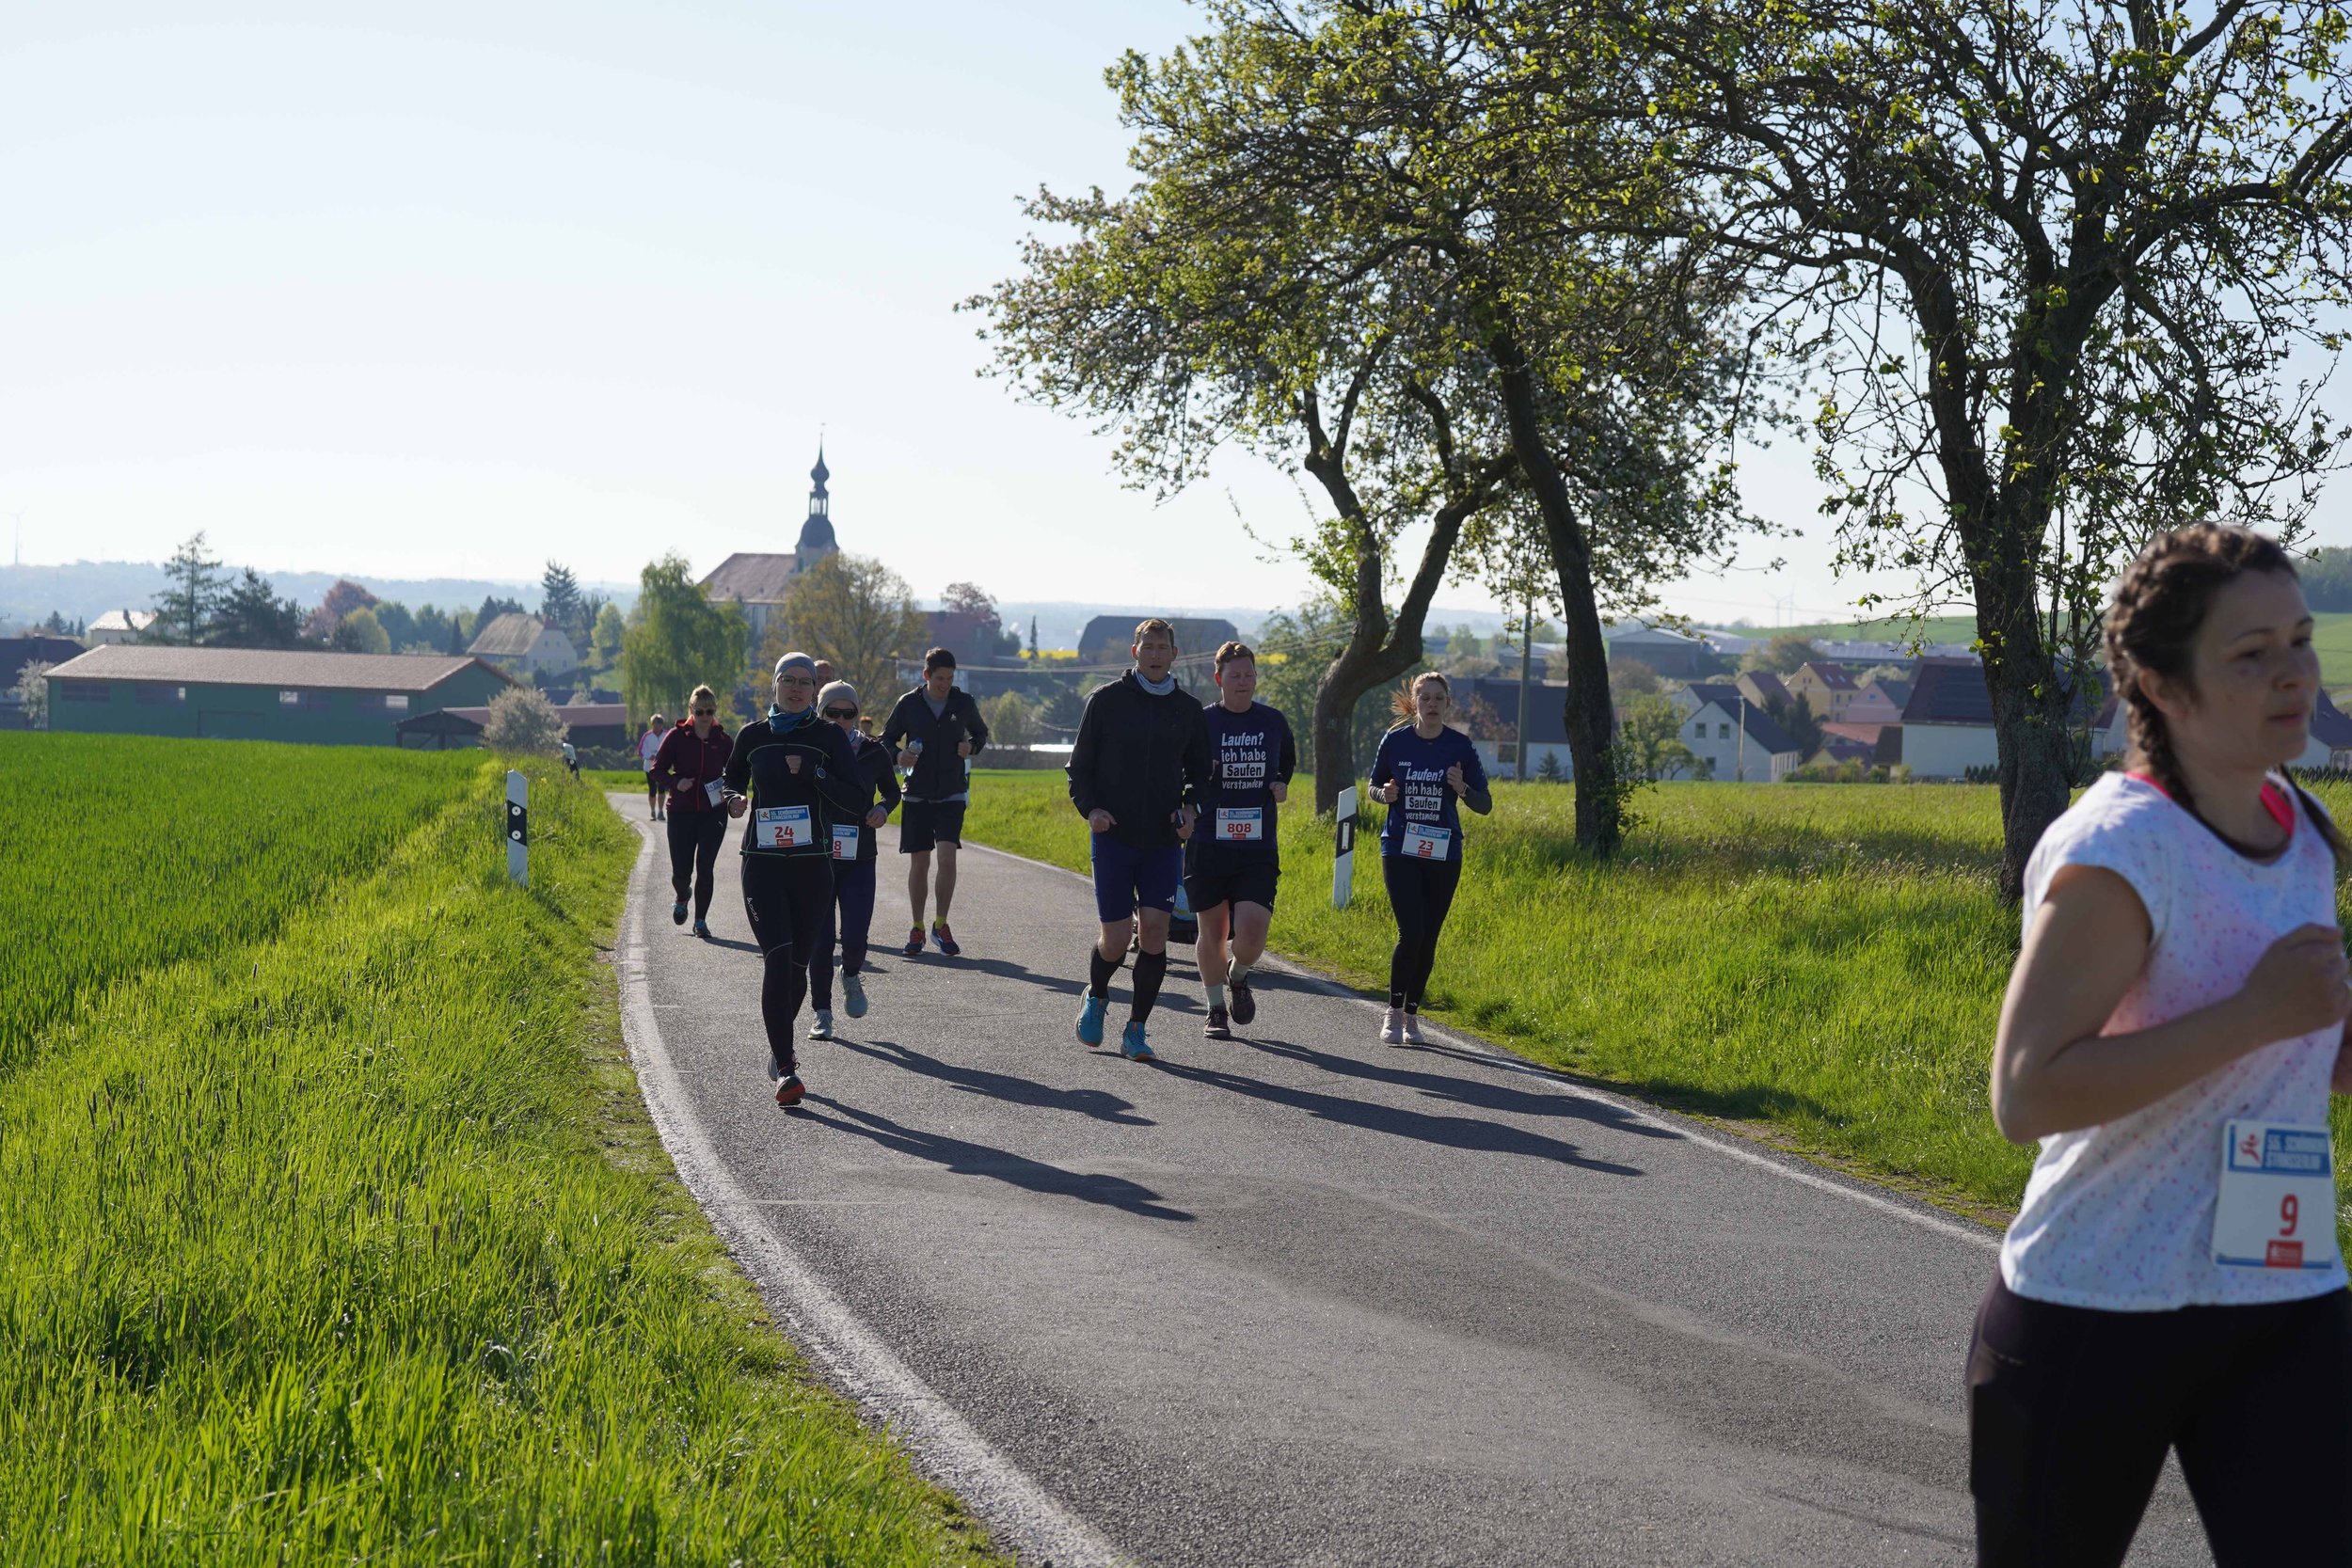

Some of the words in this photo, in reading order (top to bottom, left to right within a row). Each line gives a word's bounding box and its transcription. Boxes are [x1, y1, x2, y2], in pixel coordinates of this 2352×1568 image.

[1221, 732, 1264, 746] Laufen?
[1221, 748, 1237, 762] ich
[1240, 748, 1266, 762] habe
[1227, 764, 1262, 777] Saufen
[1406, 768, 1444, 782] Laufen?
[1221, 779, 1263, 790] verstanden
[1405, 782, 1418, 795] ich
[1421, 783, 1443, 797] habe
[1408, 797, 1438, 809] Saufen
[1406, 811, 1440, 821] verstanden
[774, 826, 795, 838] 24
[1227, 823, 1251, 832] 808
[1419, 839, 1434, 850] 23
[2280, 1193, 2299, 1237] 9
